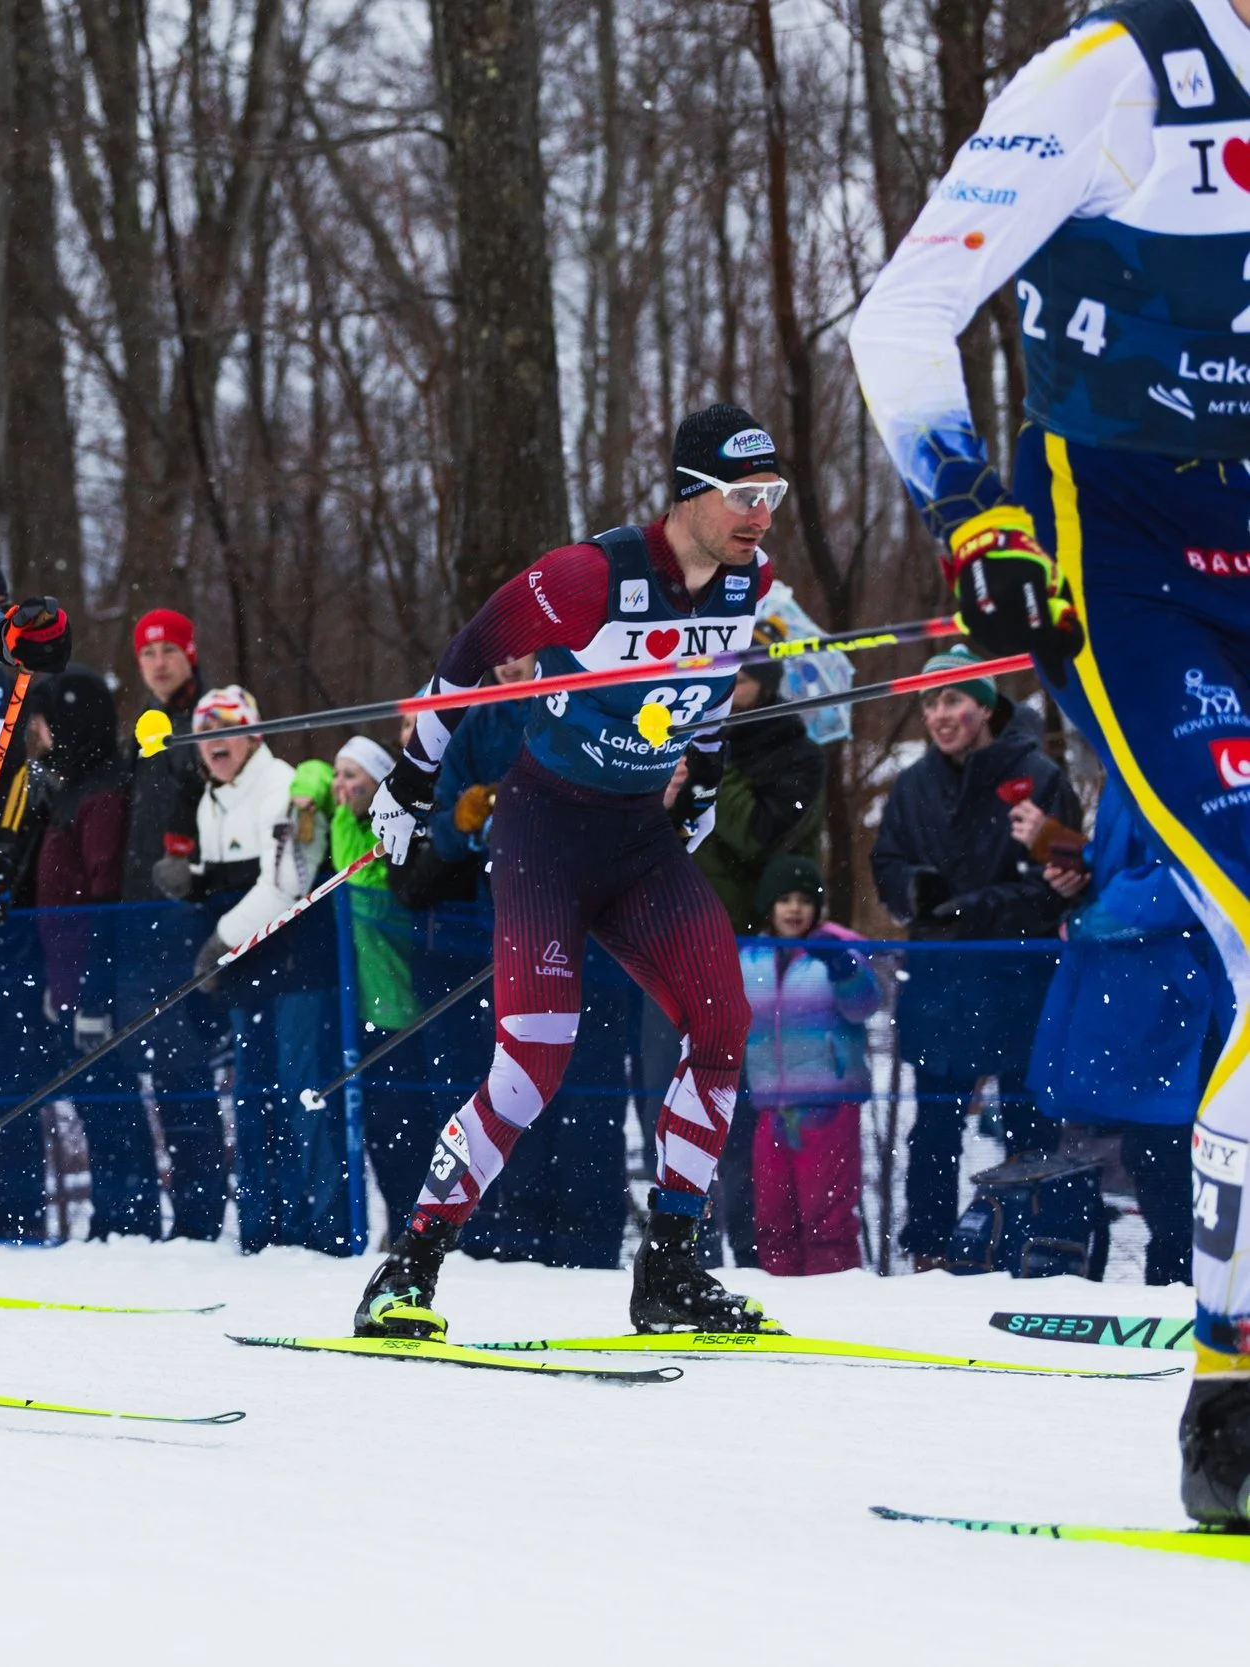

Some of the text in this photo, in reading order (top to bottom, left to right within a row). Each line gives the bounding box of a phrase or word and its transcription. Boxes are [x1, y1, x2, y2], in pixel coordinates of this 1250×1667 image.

[1189, 139, 1218, 194] I
[681, 480, 710, 496] GIESSW
[621, 625, 738, 660] I NY
[599, 728, 650, 755] Lake
[611, 759, 630, 769] MT
[630, 763, 650, 771] VAN
[535, 965, 574, 978] Löffler
[430, 1144, 456, 1181] 23
[1201, 1139, 1238, 1167] NY
[1008, 1315, 1094, 1336] SPEED
[381, 1339, 422, 1351] FISCHER
[692, 1333, 756, 1345] FISCHER
